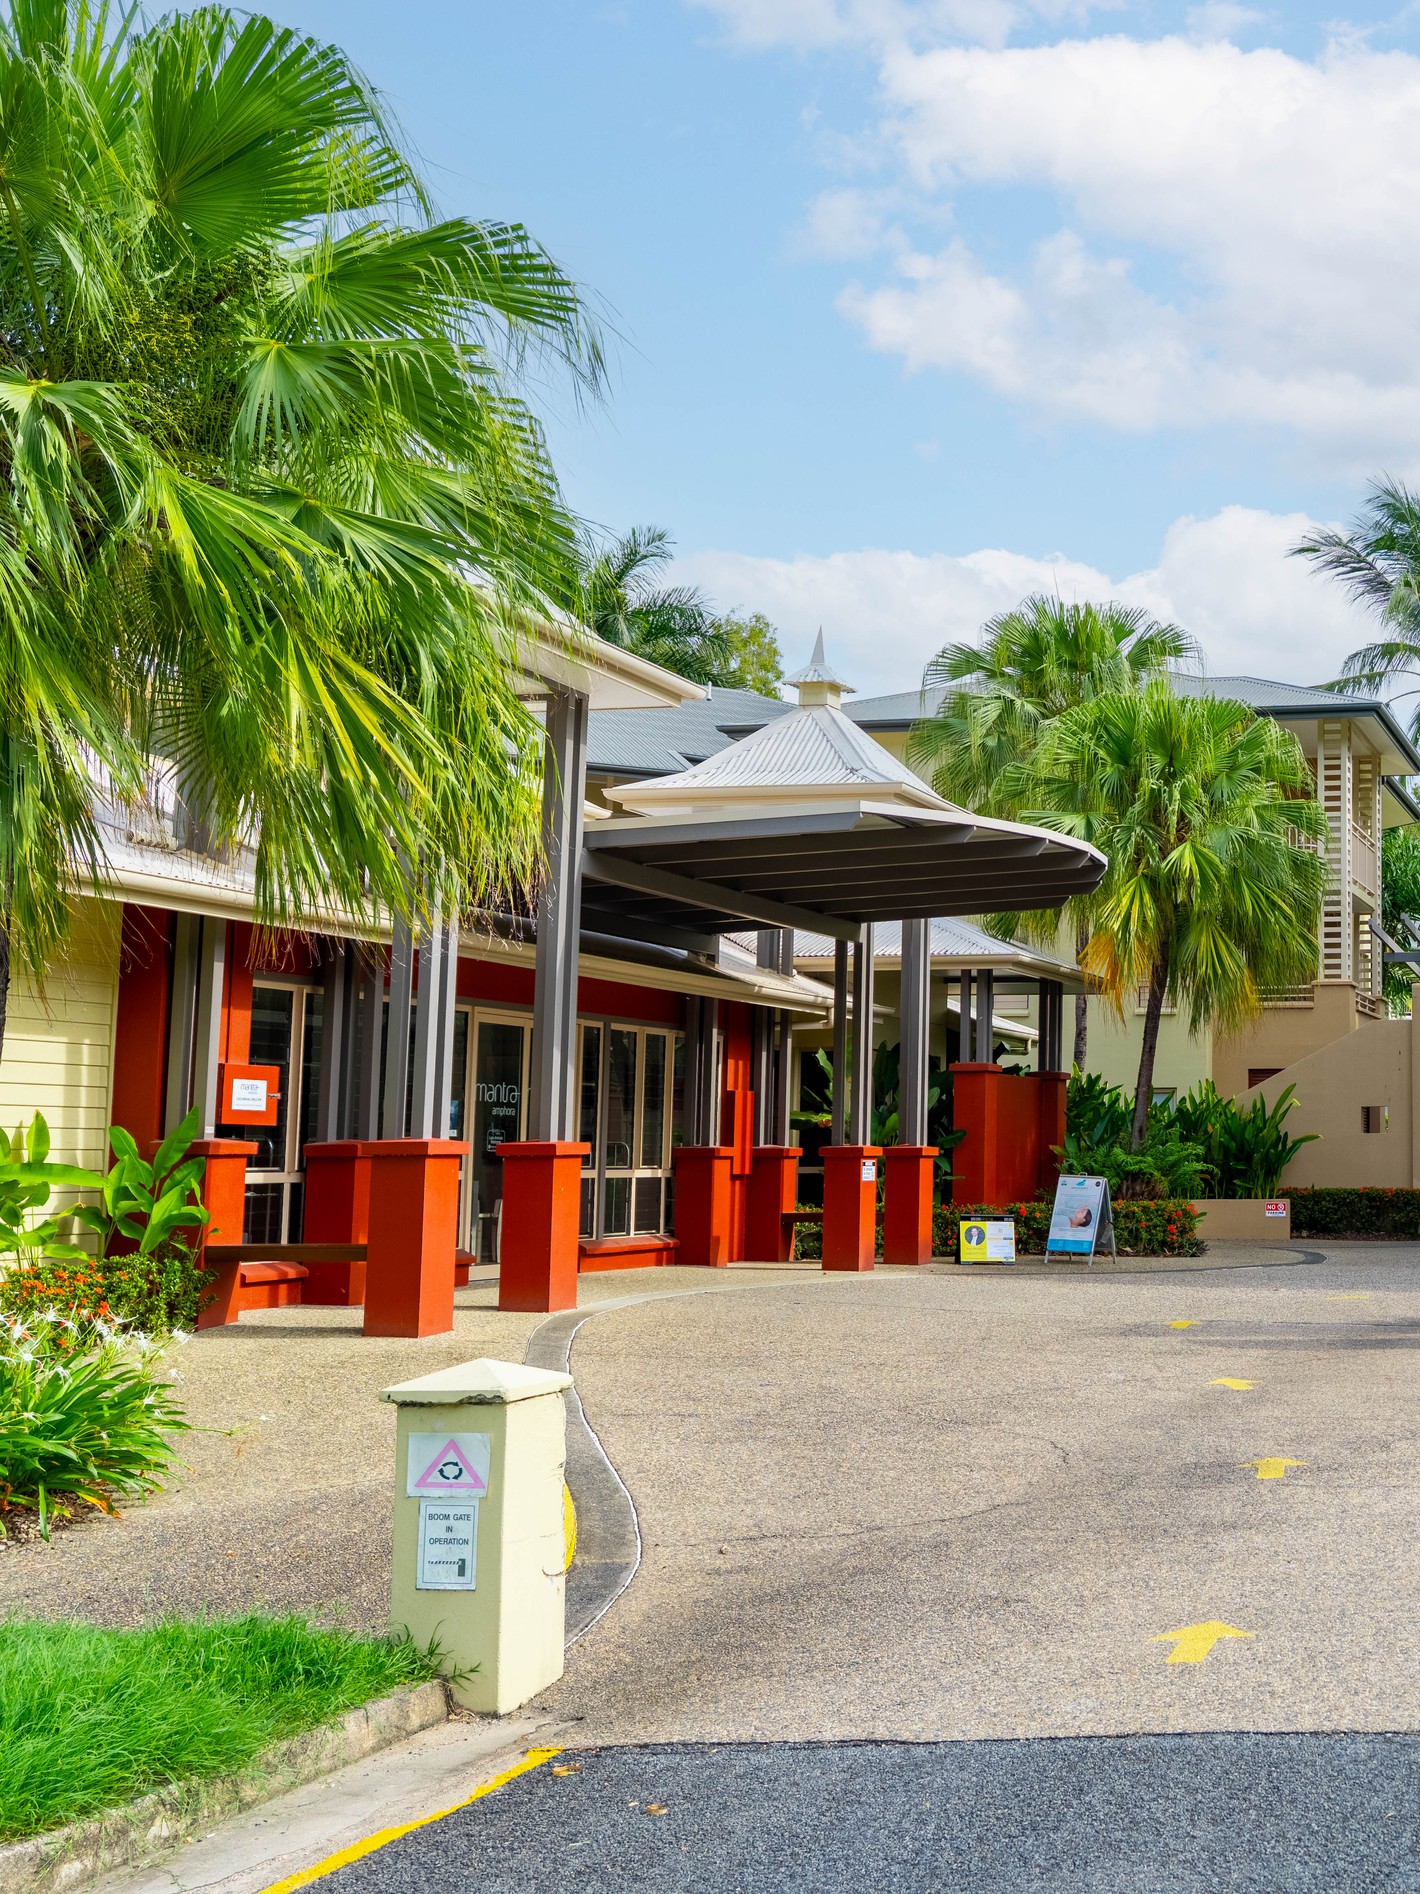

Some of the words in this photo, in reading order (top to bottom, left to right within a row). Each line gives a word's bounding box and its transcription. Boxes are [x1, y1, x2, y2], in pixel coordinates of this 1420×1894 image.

[476, 1082, 520, 1103] mantra
[492, 1106, 516, 1117] amphora
[428, 1513, 450, 1521] BOOM
[453, 1513, 471, 1521] GATE
[445, 1525, 453, 1533] IN
